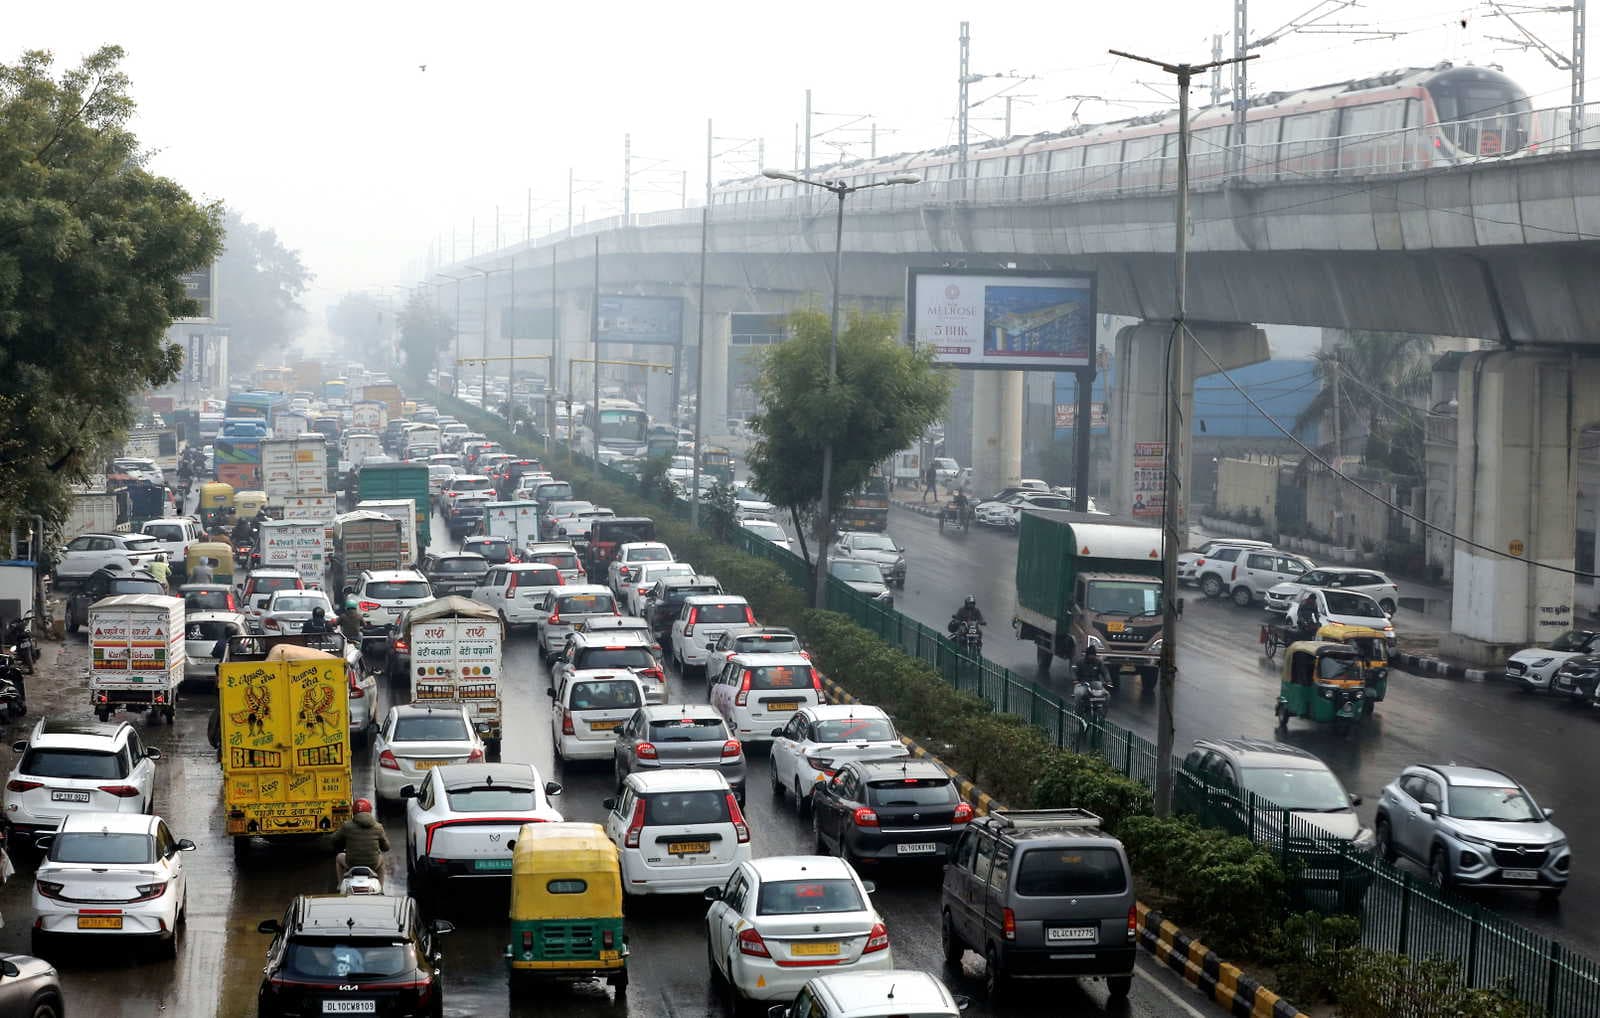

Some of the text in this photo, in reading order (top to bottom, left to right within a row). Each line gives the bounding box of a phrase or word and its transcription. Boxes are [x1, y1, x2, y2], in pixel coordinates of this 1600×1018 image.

[232, 747, 281, 768] BLOW
[298, 743, 343, 766] HORN
[326, 1001, 375, 1013] DL10CW8109
